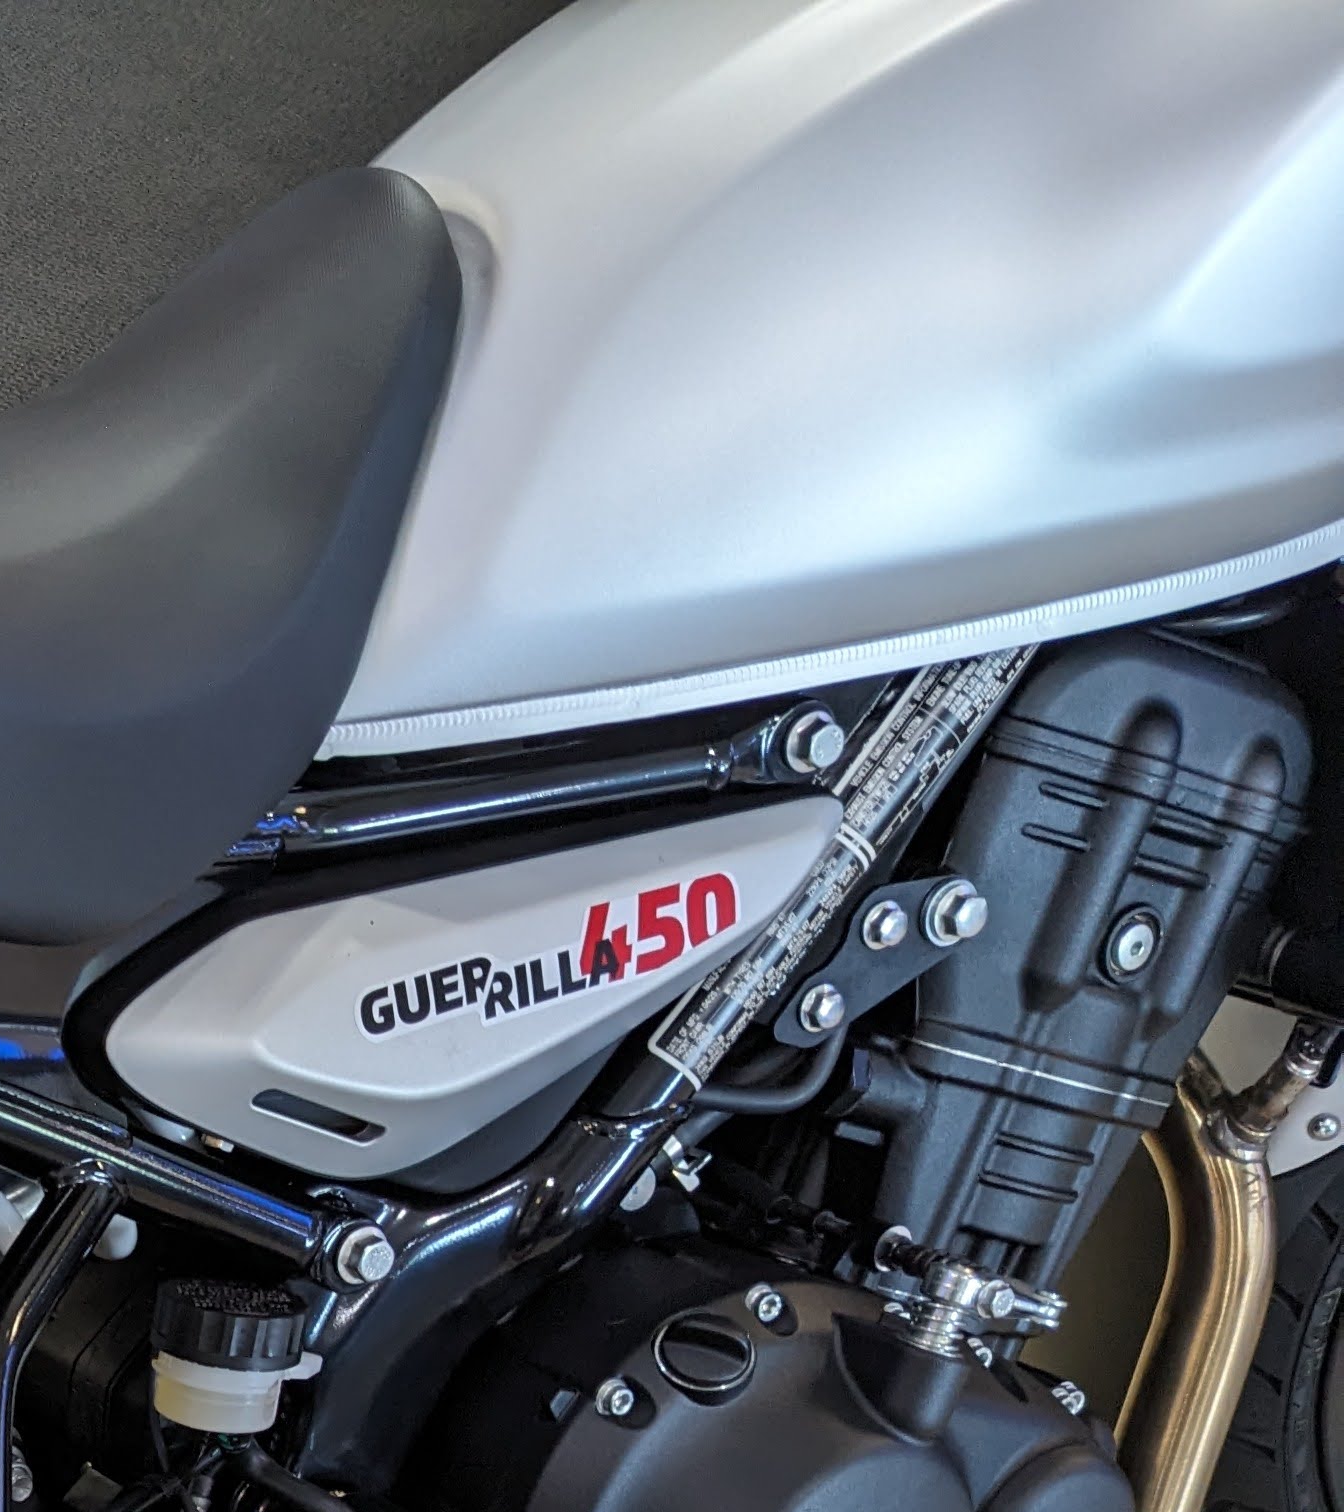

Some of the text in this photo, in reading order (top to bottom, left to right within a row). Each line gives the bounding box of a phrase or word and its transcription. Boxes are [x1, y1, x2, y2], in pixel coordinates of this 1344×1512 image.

[849, 758, 873, 788] VEHICLE
[868, 729, 895, 762] EMISSION
[890, 699, 917, 733] CONTROL
[861, 764, 886, 794] EMISSION
[880, 738, 905, 768] CONTROL
[900, 713, 923, 742] SYSTEM
[360, 940, 620, 1034] GUERRILLA
[580, 873, 736, 983] 450
